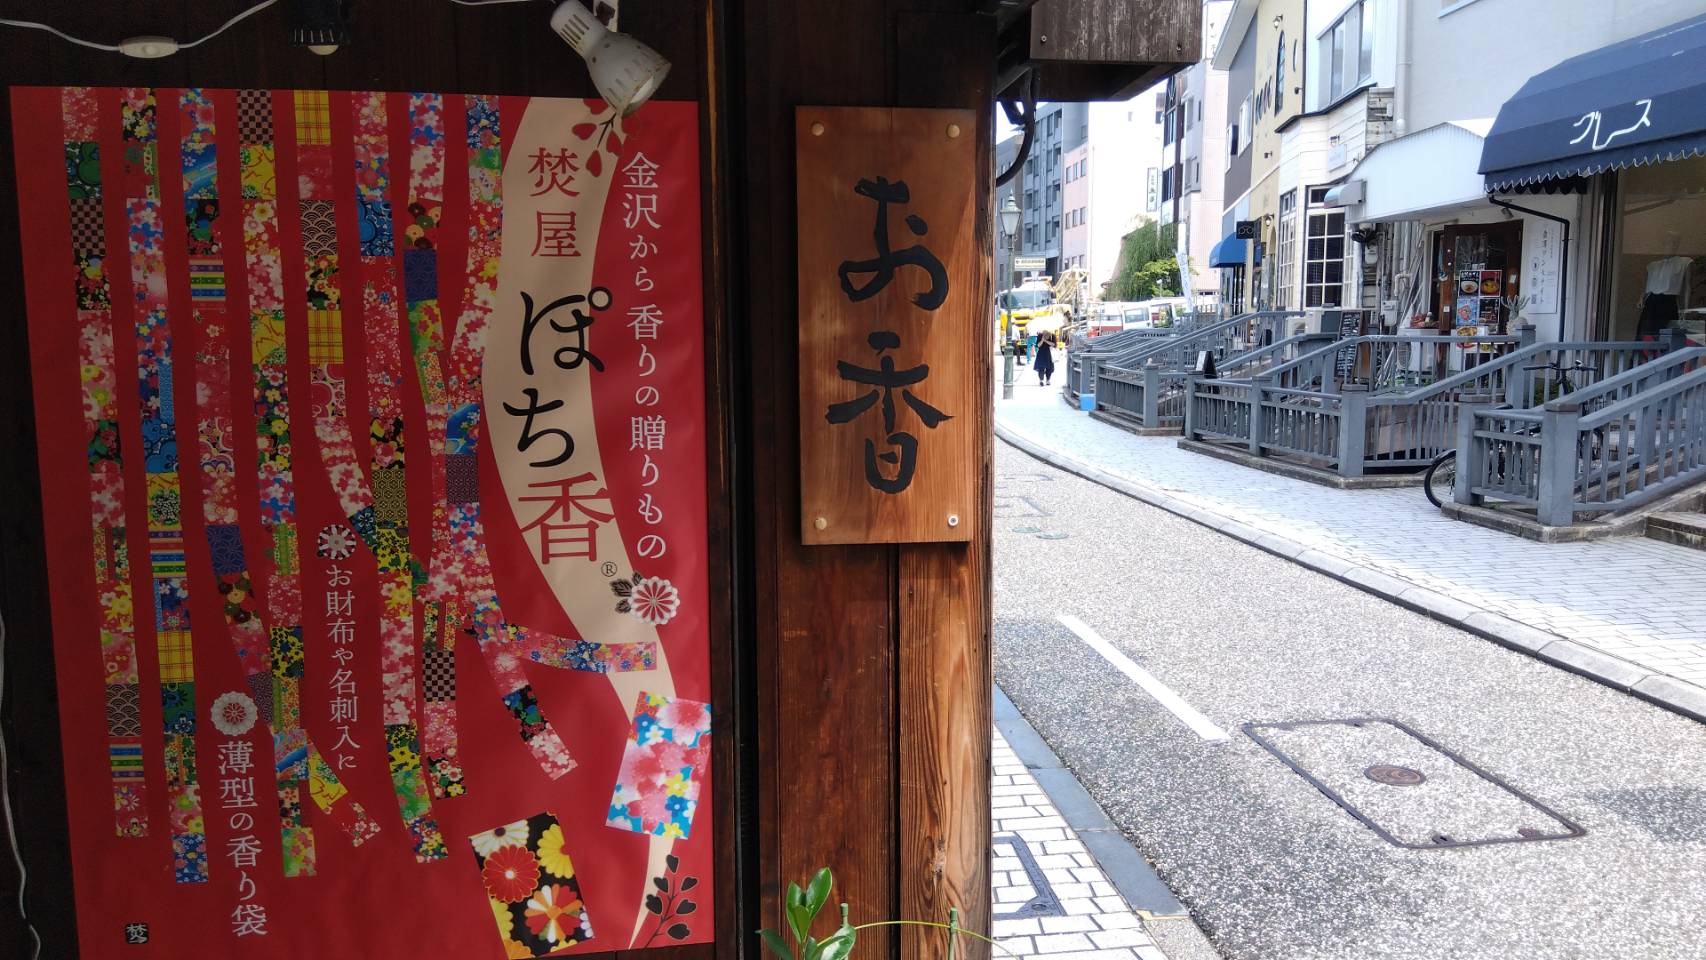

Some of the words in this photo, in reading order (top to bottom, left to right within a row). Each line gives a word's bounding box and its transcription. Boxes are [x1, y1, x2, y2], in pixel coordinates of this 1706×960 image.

[526, 146, 582, 258] 焚屋
[503, 286, 615, 565] ぽち香
[621, 151, 667, 559] 金沢から香りの贈りもの
[825, 175, 954, 495] お香
[325, 565, 360, 770] お財布や名刺入に
[217, 741, 268, 937] 薄型の香り袋
